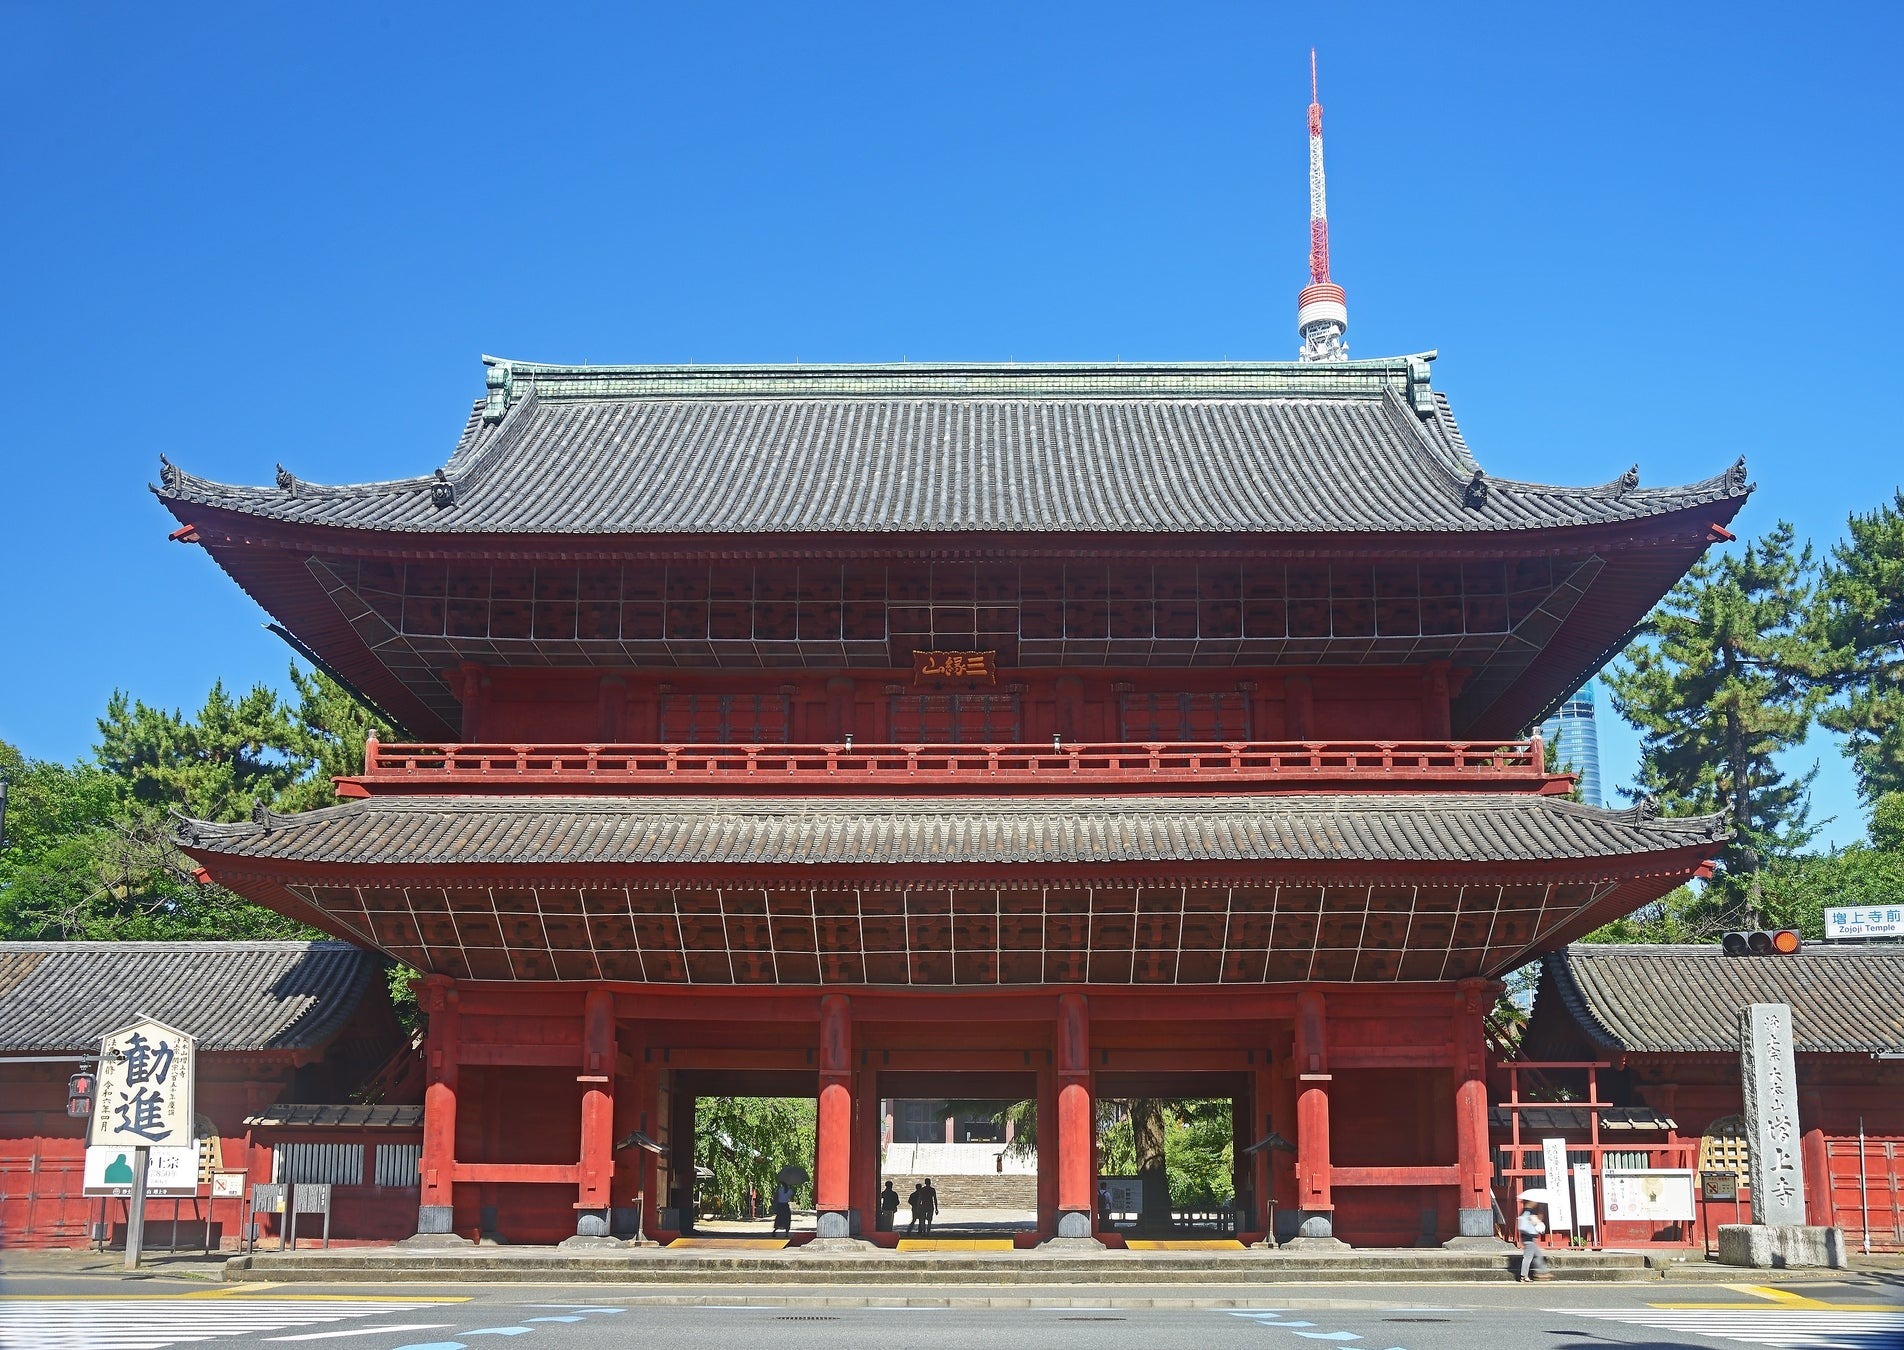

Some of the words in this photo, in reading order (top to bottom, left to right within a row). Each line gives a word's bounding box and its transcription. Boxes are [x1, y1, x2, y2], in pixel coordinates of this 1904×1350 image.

[1832, 909, 1901, 925] 増上寺前
[1839, 925, 1863, 934] Zojoji
[1865, 924, 1896, 932] Temple
[114, 1032, 174, 1142] 勧進
